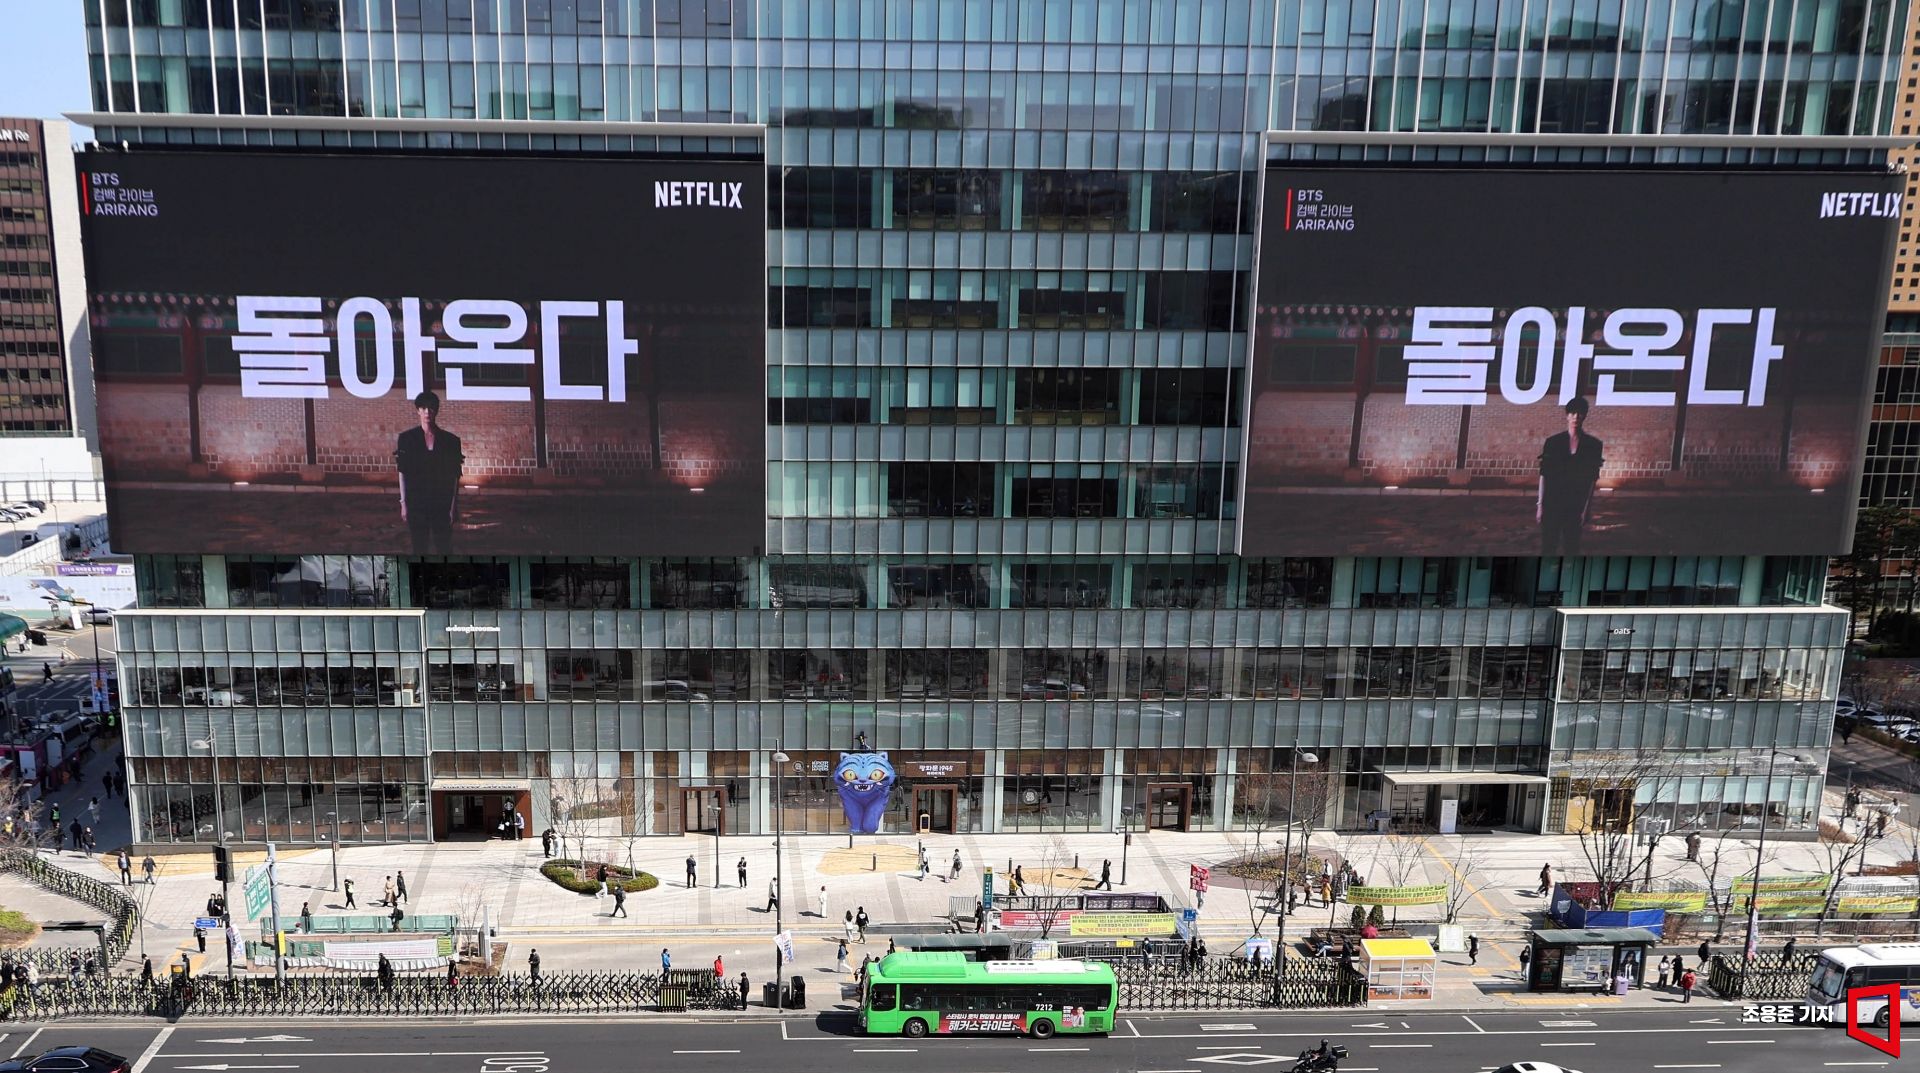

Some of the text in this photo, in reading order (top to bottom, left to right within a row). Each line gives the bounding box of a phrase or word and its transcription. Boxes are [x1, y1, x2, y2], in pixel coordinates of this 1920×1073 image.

[92, 172, 120, 186] BTS
[93, 187, 154, 203] 컴백 라이브
[654, 181, 743, 210] NETFLIX
[1297, 189, 1324, 202] BTS
[95, 203, 159, 217] ARIRANG
[1296, 204, 1354, 218] 컴백 라이브
[1820, 191, 1903, 219] NETFLIX
[1295, 218, 1355, 231] ARIRANG
[231, 295, 639, 403] 돌아온다
[1402, 305, 1784, 407] 돌아온다
[1035, 1003, 1053, 1011] 7212
[948, 1020, 980, 1031] 해커스
